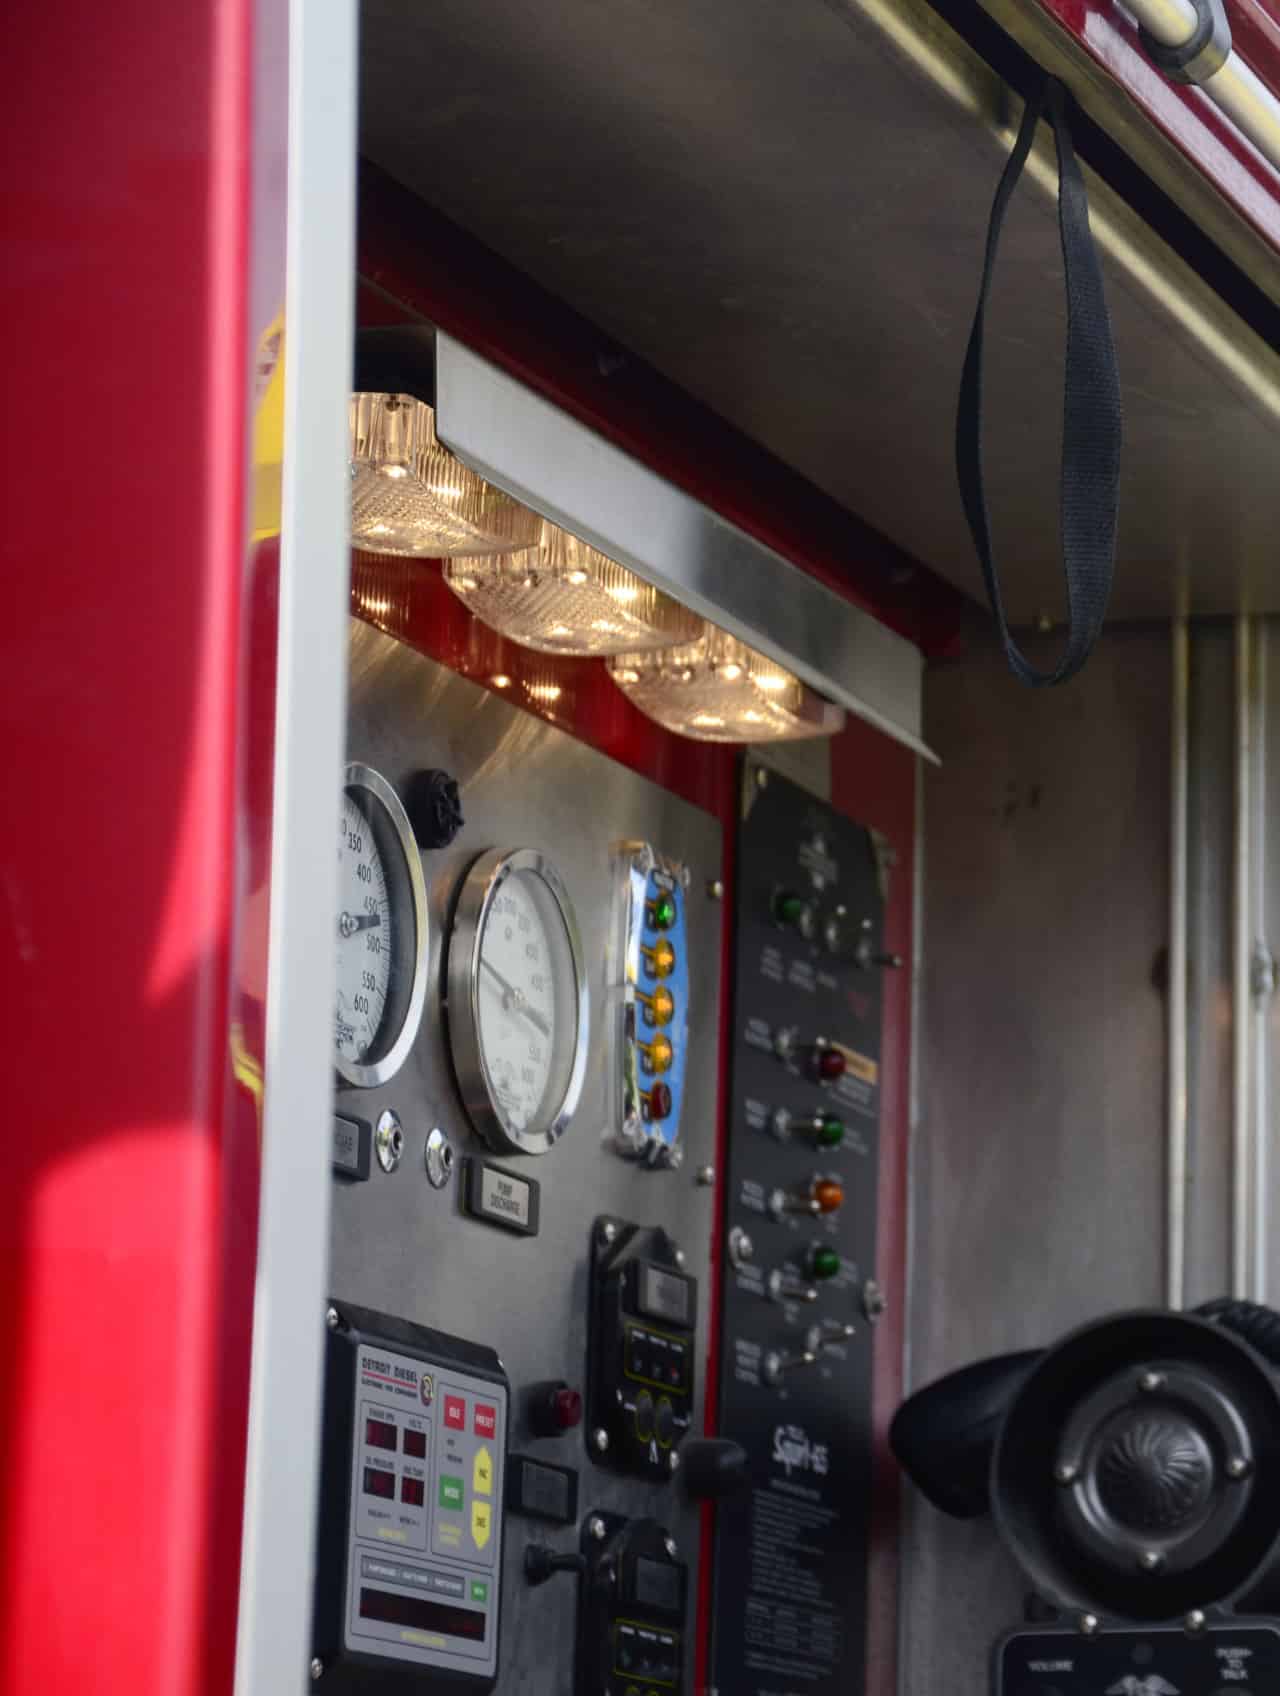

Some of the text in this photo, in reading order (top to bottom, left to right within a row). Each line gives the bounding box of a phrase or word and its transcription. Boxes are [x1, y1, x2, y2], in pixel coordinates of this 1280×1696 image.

[348, 831, 362, 854] 350
[356, 863, 372, 884] 400
[362, 970, 375, 992] 550
[354, 993, 369, 1015] 600
[361, 1357, 418, 1384] DETROIT DIESEL
